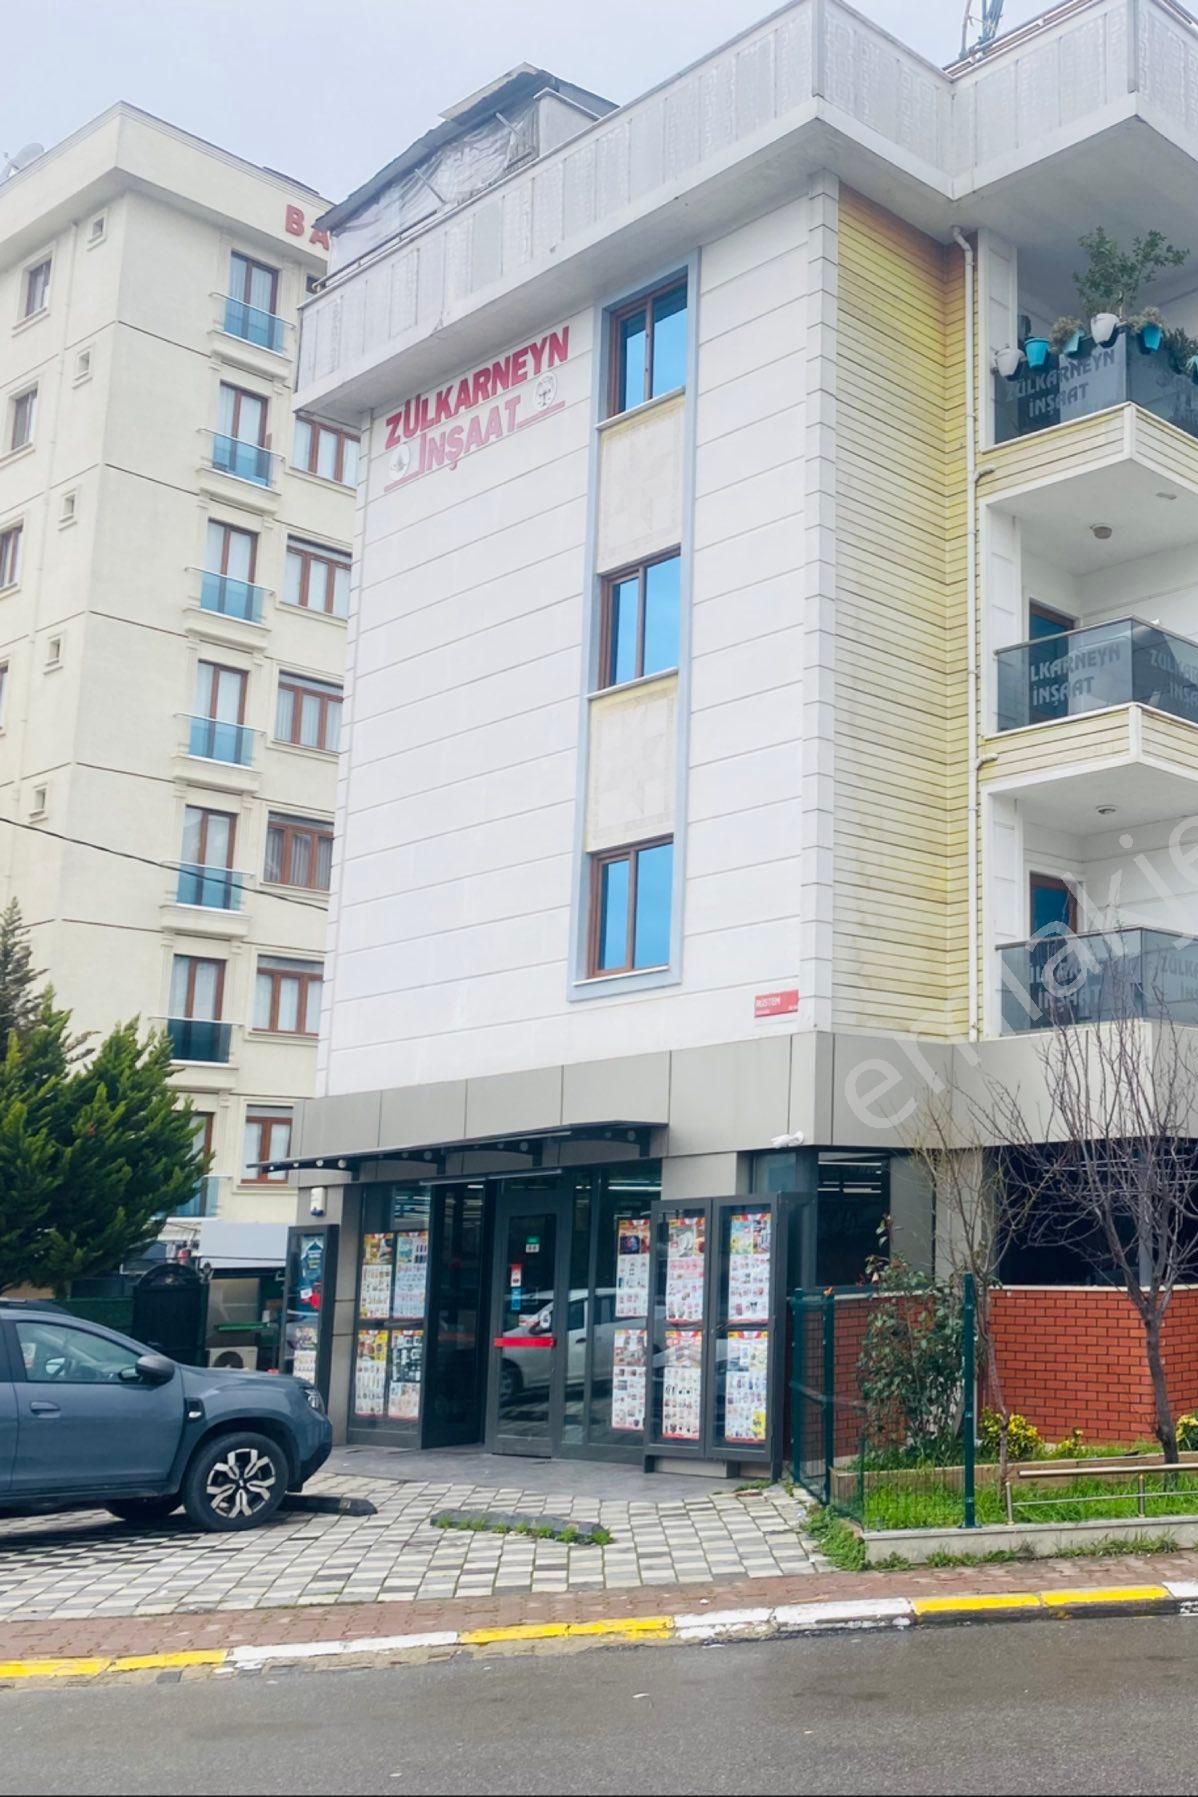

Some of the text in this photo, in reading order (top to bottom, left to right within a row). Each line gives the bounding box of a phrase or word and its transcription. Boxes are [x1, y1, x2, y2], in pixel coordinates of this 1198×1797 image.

[384, 325, 570, 450] ZÜLKARNEYN
[1007, 349, 1116, 401] ÜLKARNEYN
[1029, 643, 1121, 682] LKARNEYN
